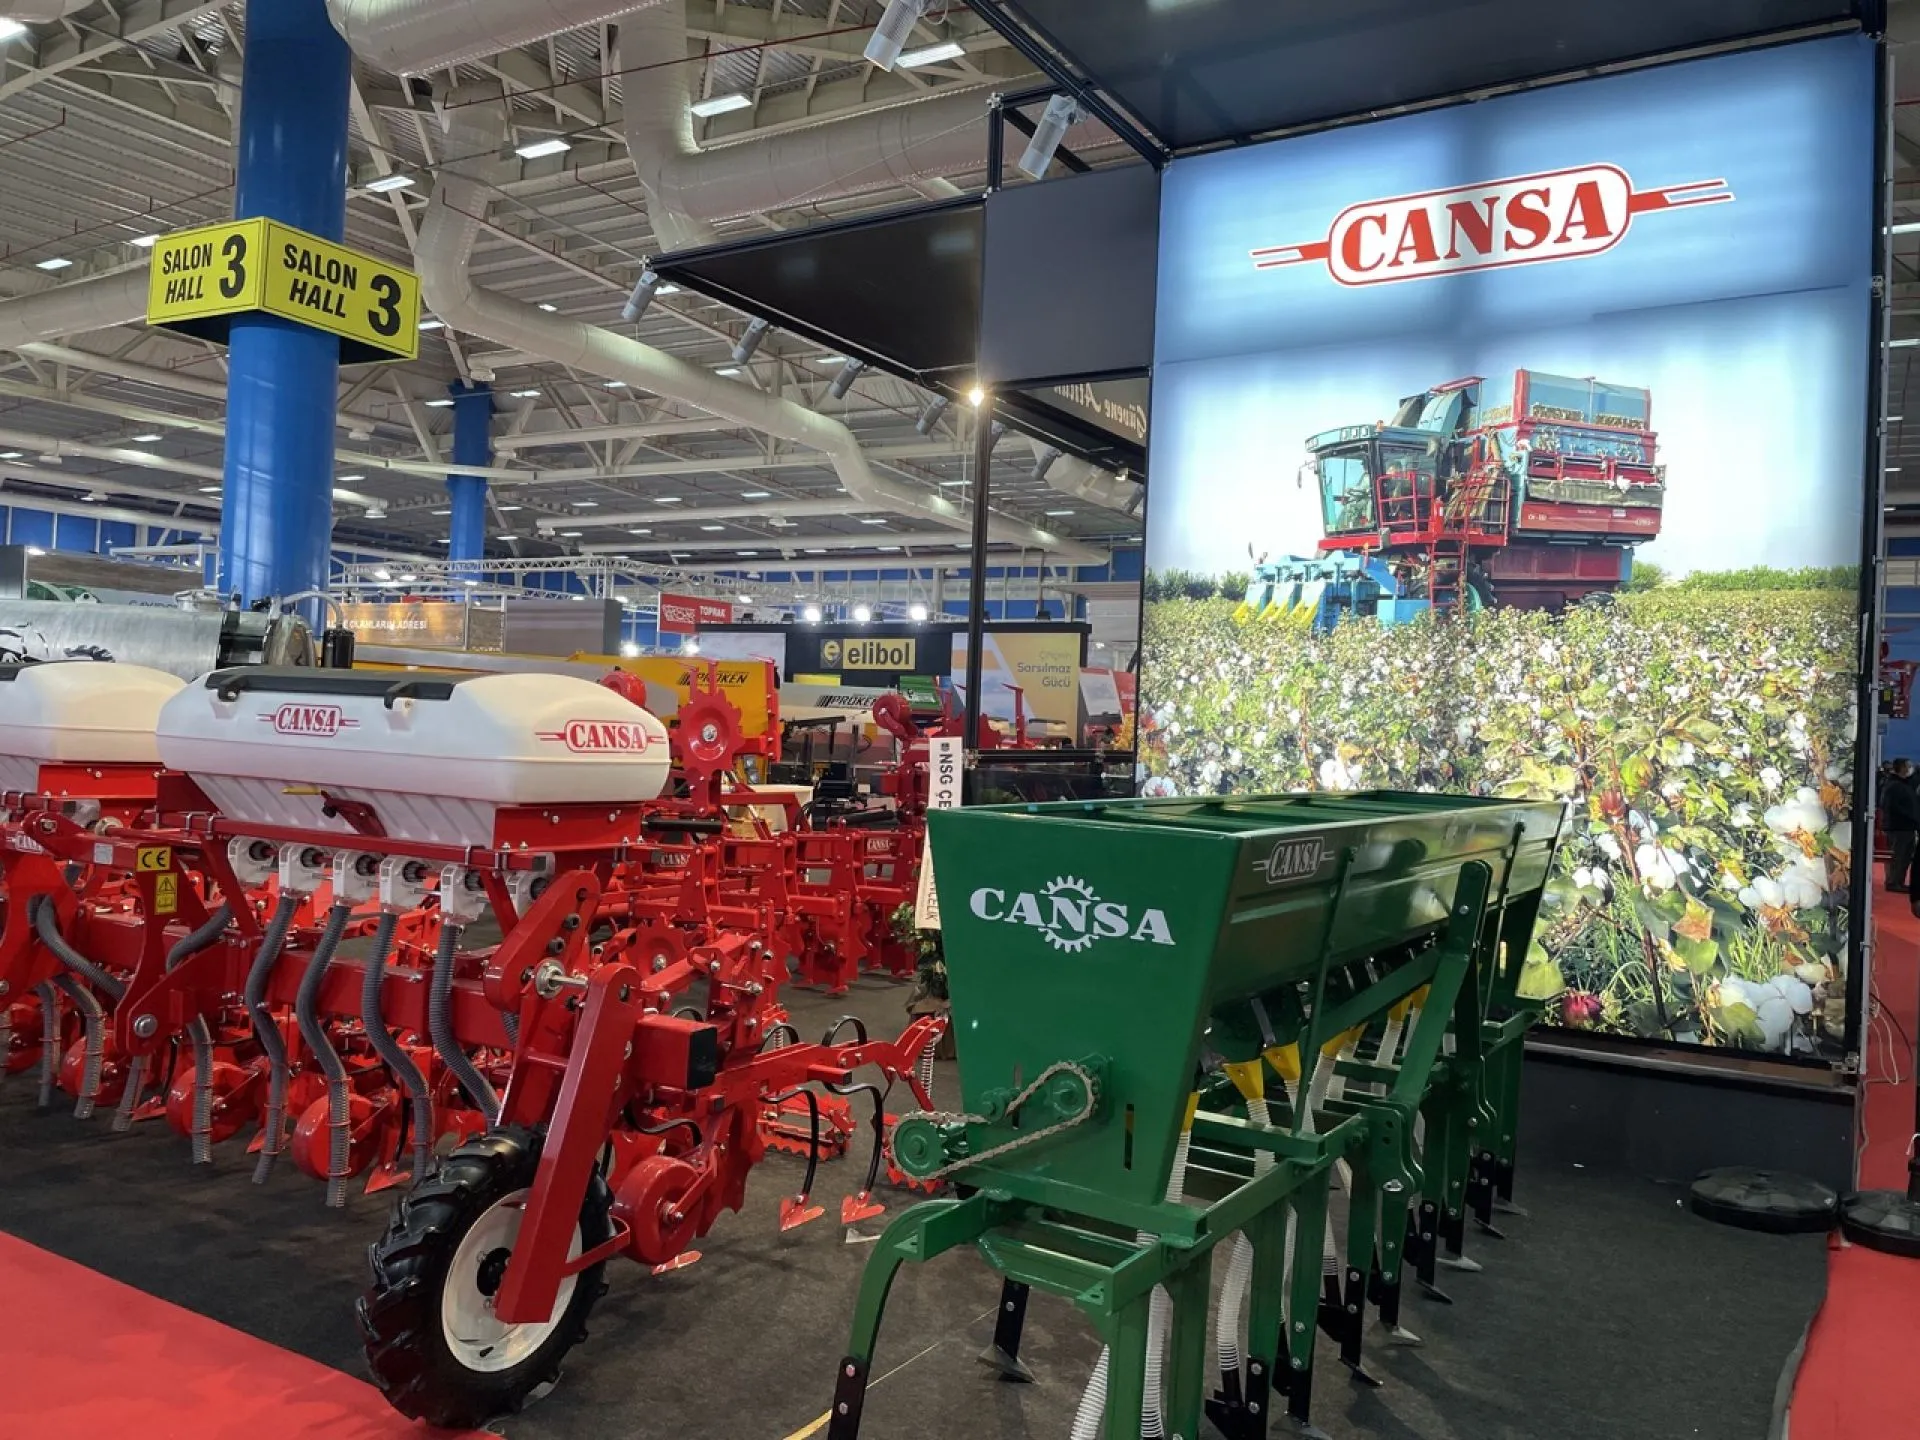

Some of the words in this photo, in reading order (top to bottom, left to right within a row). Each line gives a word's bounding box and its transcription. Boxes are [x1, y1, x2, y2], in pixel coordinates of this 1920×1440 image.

[1341, 179, 1613, 274] CANSA
[163, 242, 213, 275] SALON
[219, 234, 247, 298] 3
[284, 243, 357, 290] SALON
[165, 275, 203, 304] HALL
[289, 278, 346, 318] HALL
[368, 274, 401, 337] 3
[848, 641, 910, 665] elibol
[278, 707, 336, 733] CANSA
[570, 723, 644, 749] CANSA
[939, 753, 954, 785] NSG
[142, 850, 166, 868] CE
[1271, 842, 1321, 877] CANSA
[969, 887, 1176, 946] CANSA
